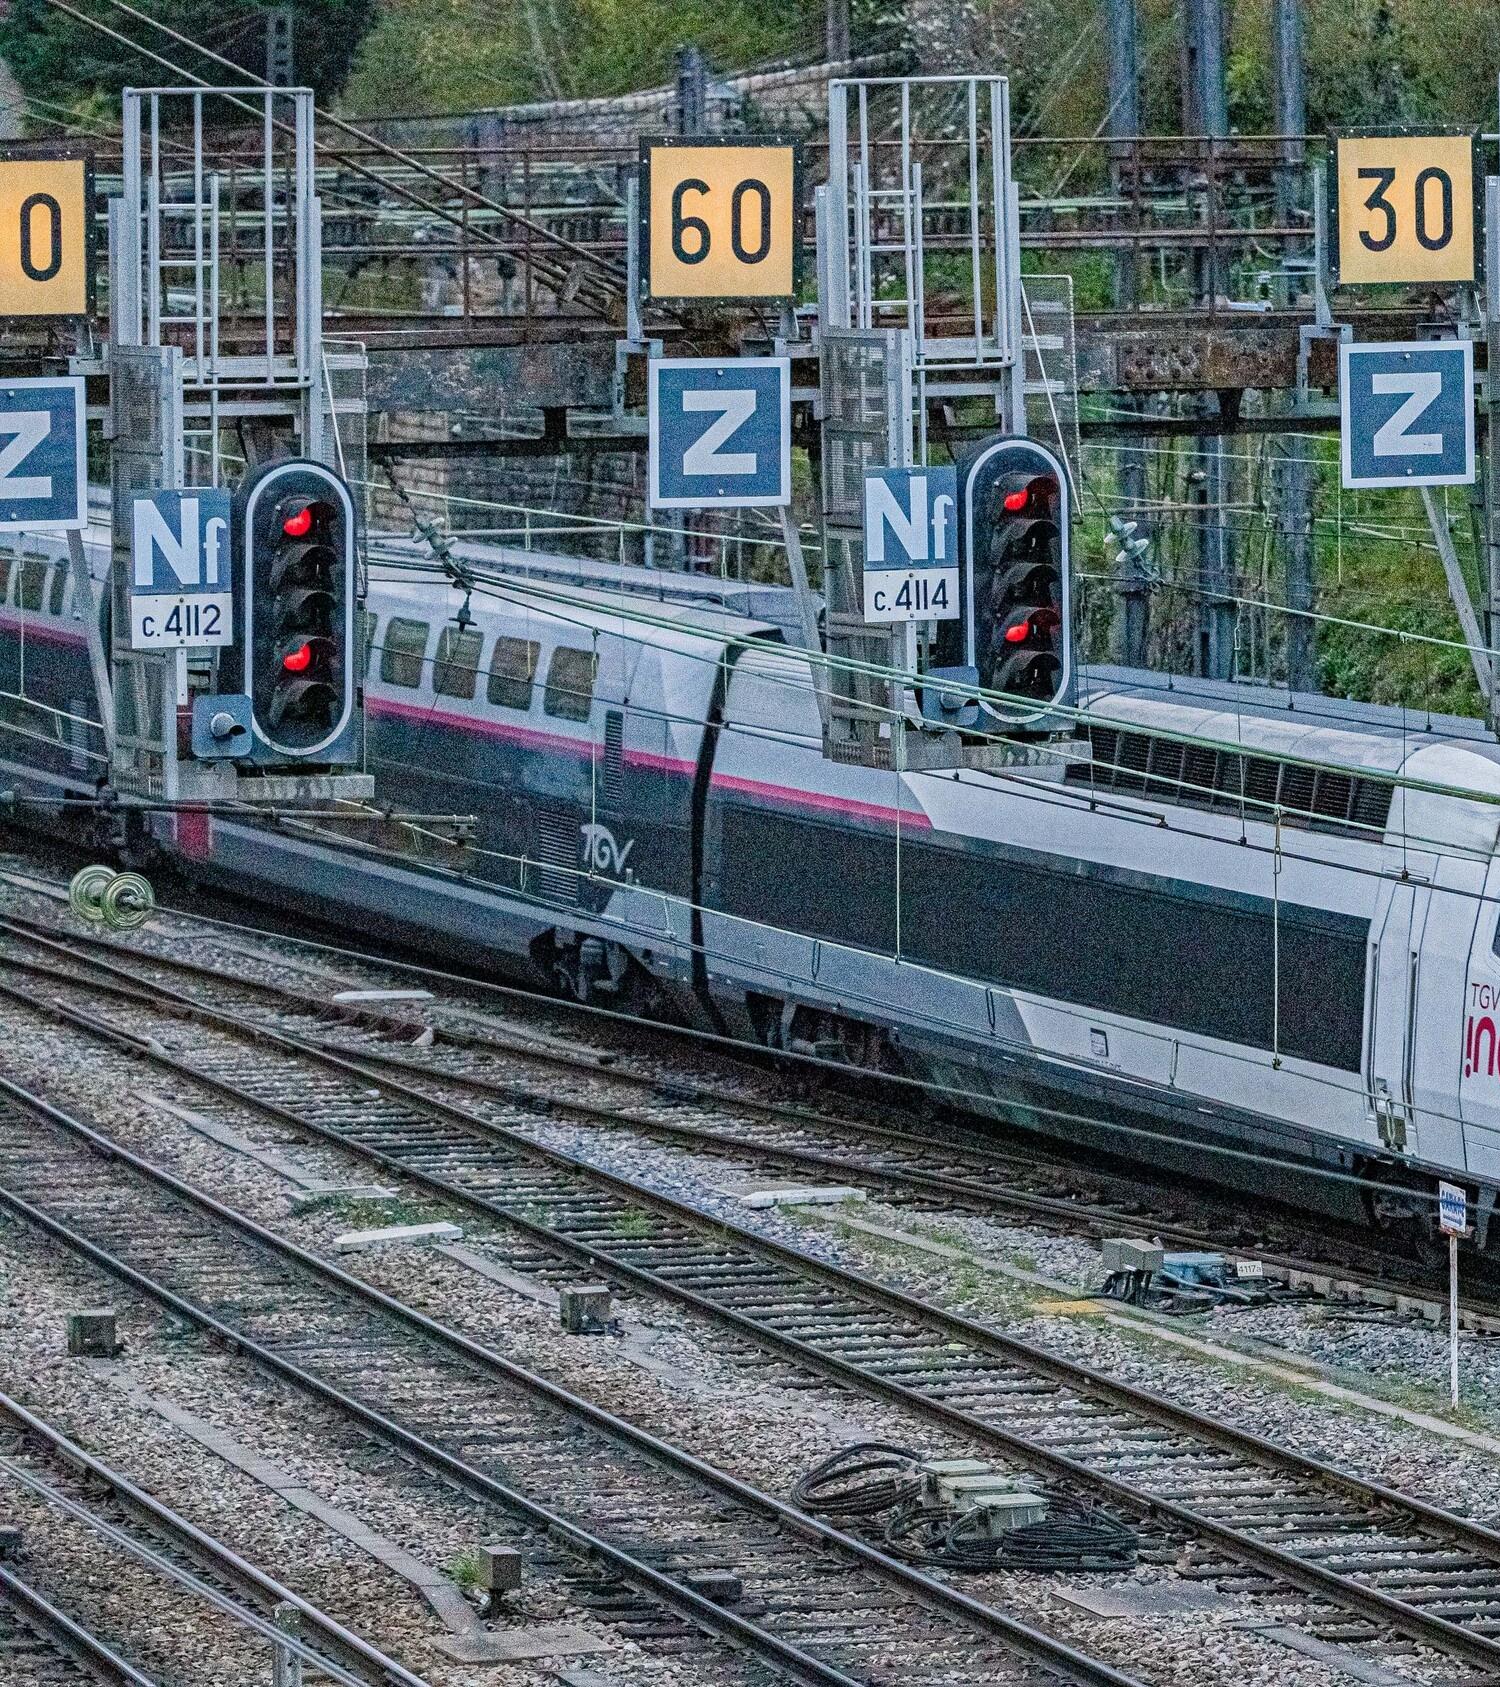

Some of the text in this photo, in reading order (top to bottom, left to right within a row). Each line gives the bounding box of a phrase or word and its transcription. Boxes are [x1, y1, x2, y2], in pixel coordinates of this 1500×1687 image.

[20, 192, 62, 281] 0
[672, 178, 771, 265] 60
[1358, 166, 1453, 252] 30
[0, 411, 52, 498] Z
[683, 389, 757, 476] Z
[1372, 372, 1443, 457] Z
[134, 498, 227, 585] Nf
[865, 476, 953, 561] Nf
[142, 604, 221, 637] c.4112
[874, 578, 949, 611] c.4114
[581, 824, 634, 874] TGV
